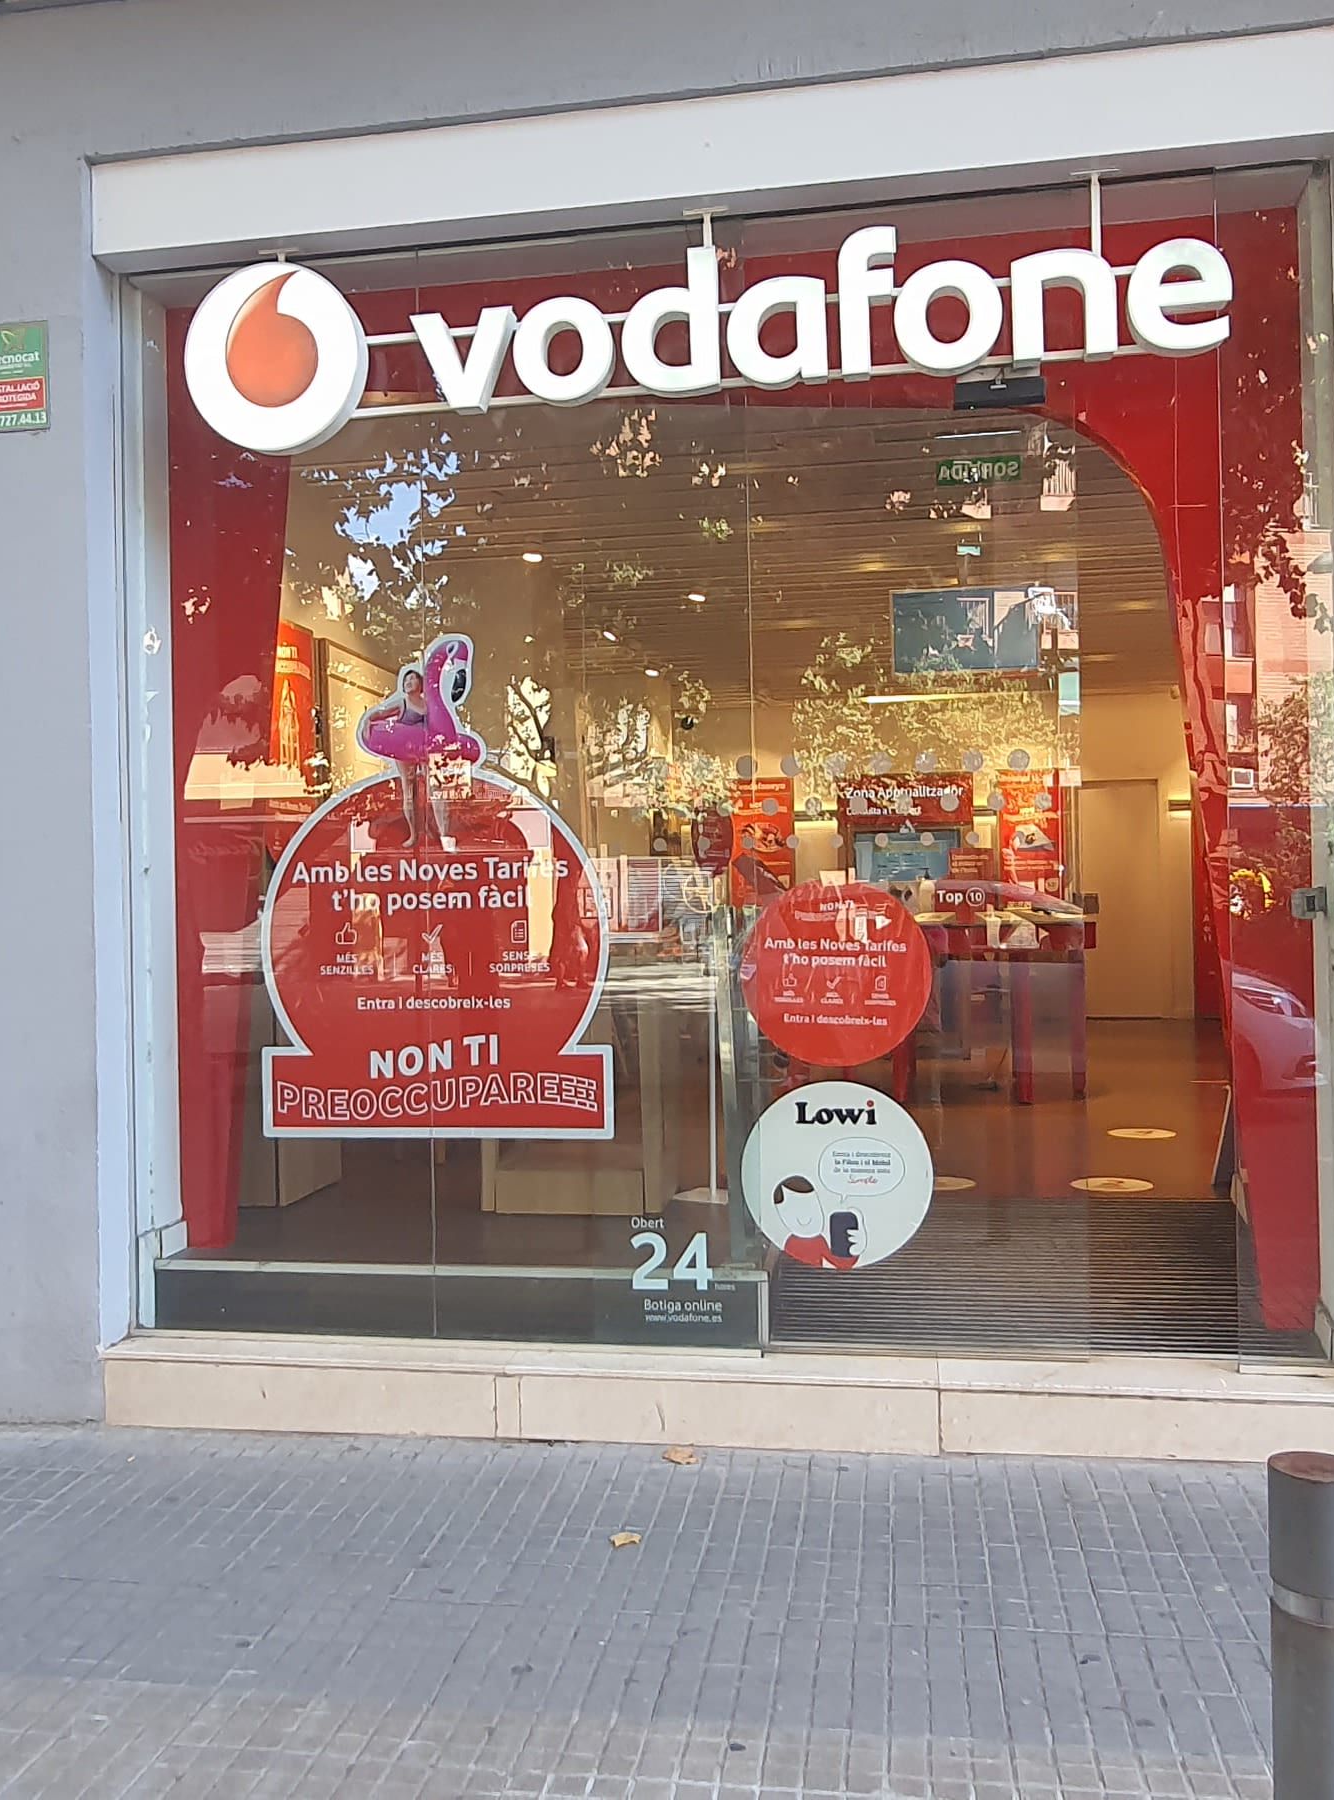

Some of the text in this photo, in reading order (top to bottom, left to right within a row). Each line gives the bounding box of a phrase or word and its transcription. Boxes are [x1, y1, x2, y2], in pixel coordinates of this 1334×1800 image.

[409, 224, 1234, 415] vodafone
[846, 787, 875, 799] Zona
[292, 855, 568, 884] Amb les Noves Tarifes
[332, 884, 533, 916] t'ho posem fàcil
[937, 890, 964, 906] Top
[765, 937, 795, 950] Amb
[798, 938, 817, 951] les
[820, 938, 860, 951] Noves
[812, 955, 856, 968] posem
[357, 997, 395, 1010] Entra
[406, 995, 511, 1010] descobreix-les
[784, 1013, 810, 1024] Entra
[370, 1033, 499, 1079] NON TI
[795, 1099, 877, 1125] Lowi
[631, 1216, 665, 1229] Obert
[630, 1231, 714, 1291] 24
[644, 1298, 723, 1313] Botiga online
[645, 1313, 723, 1323] www.vodafone.es
